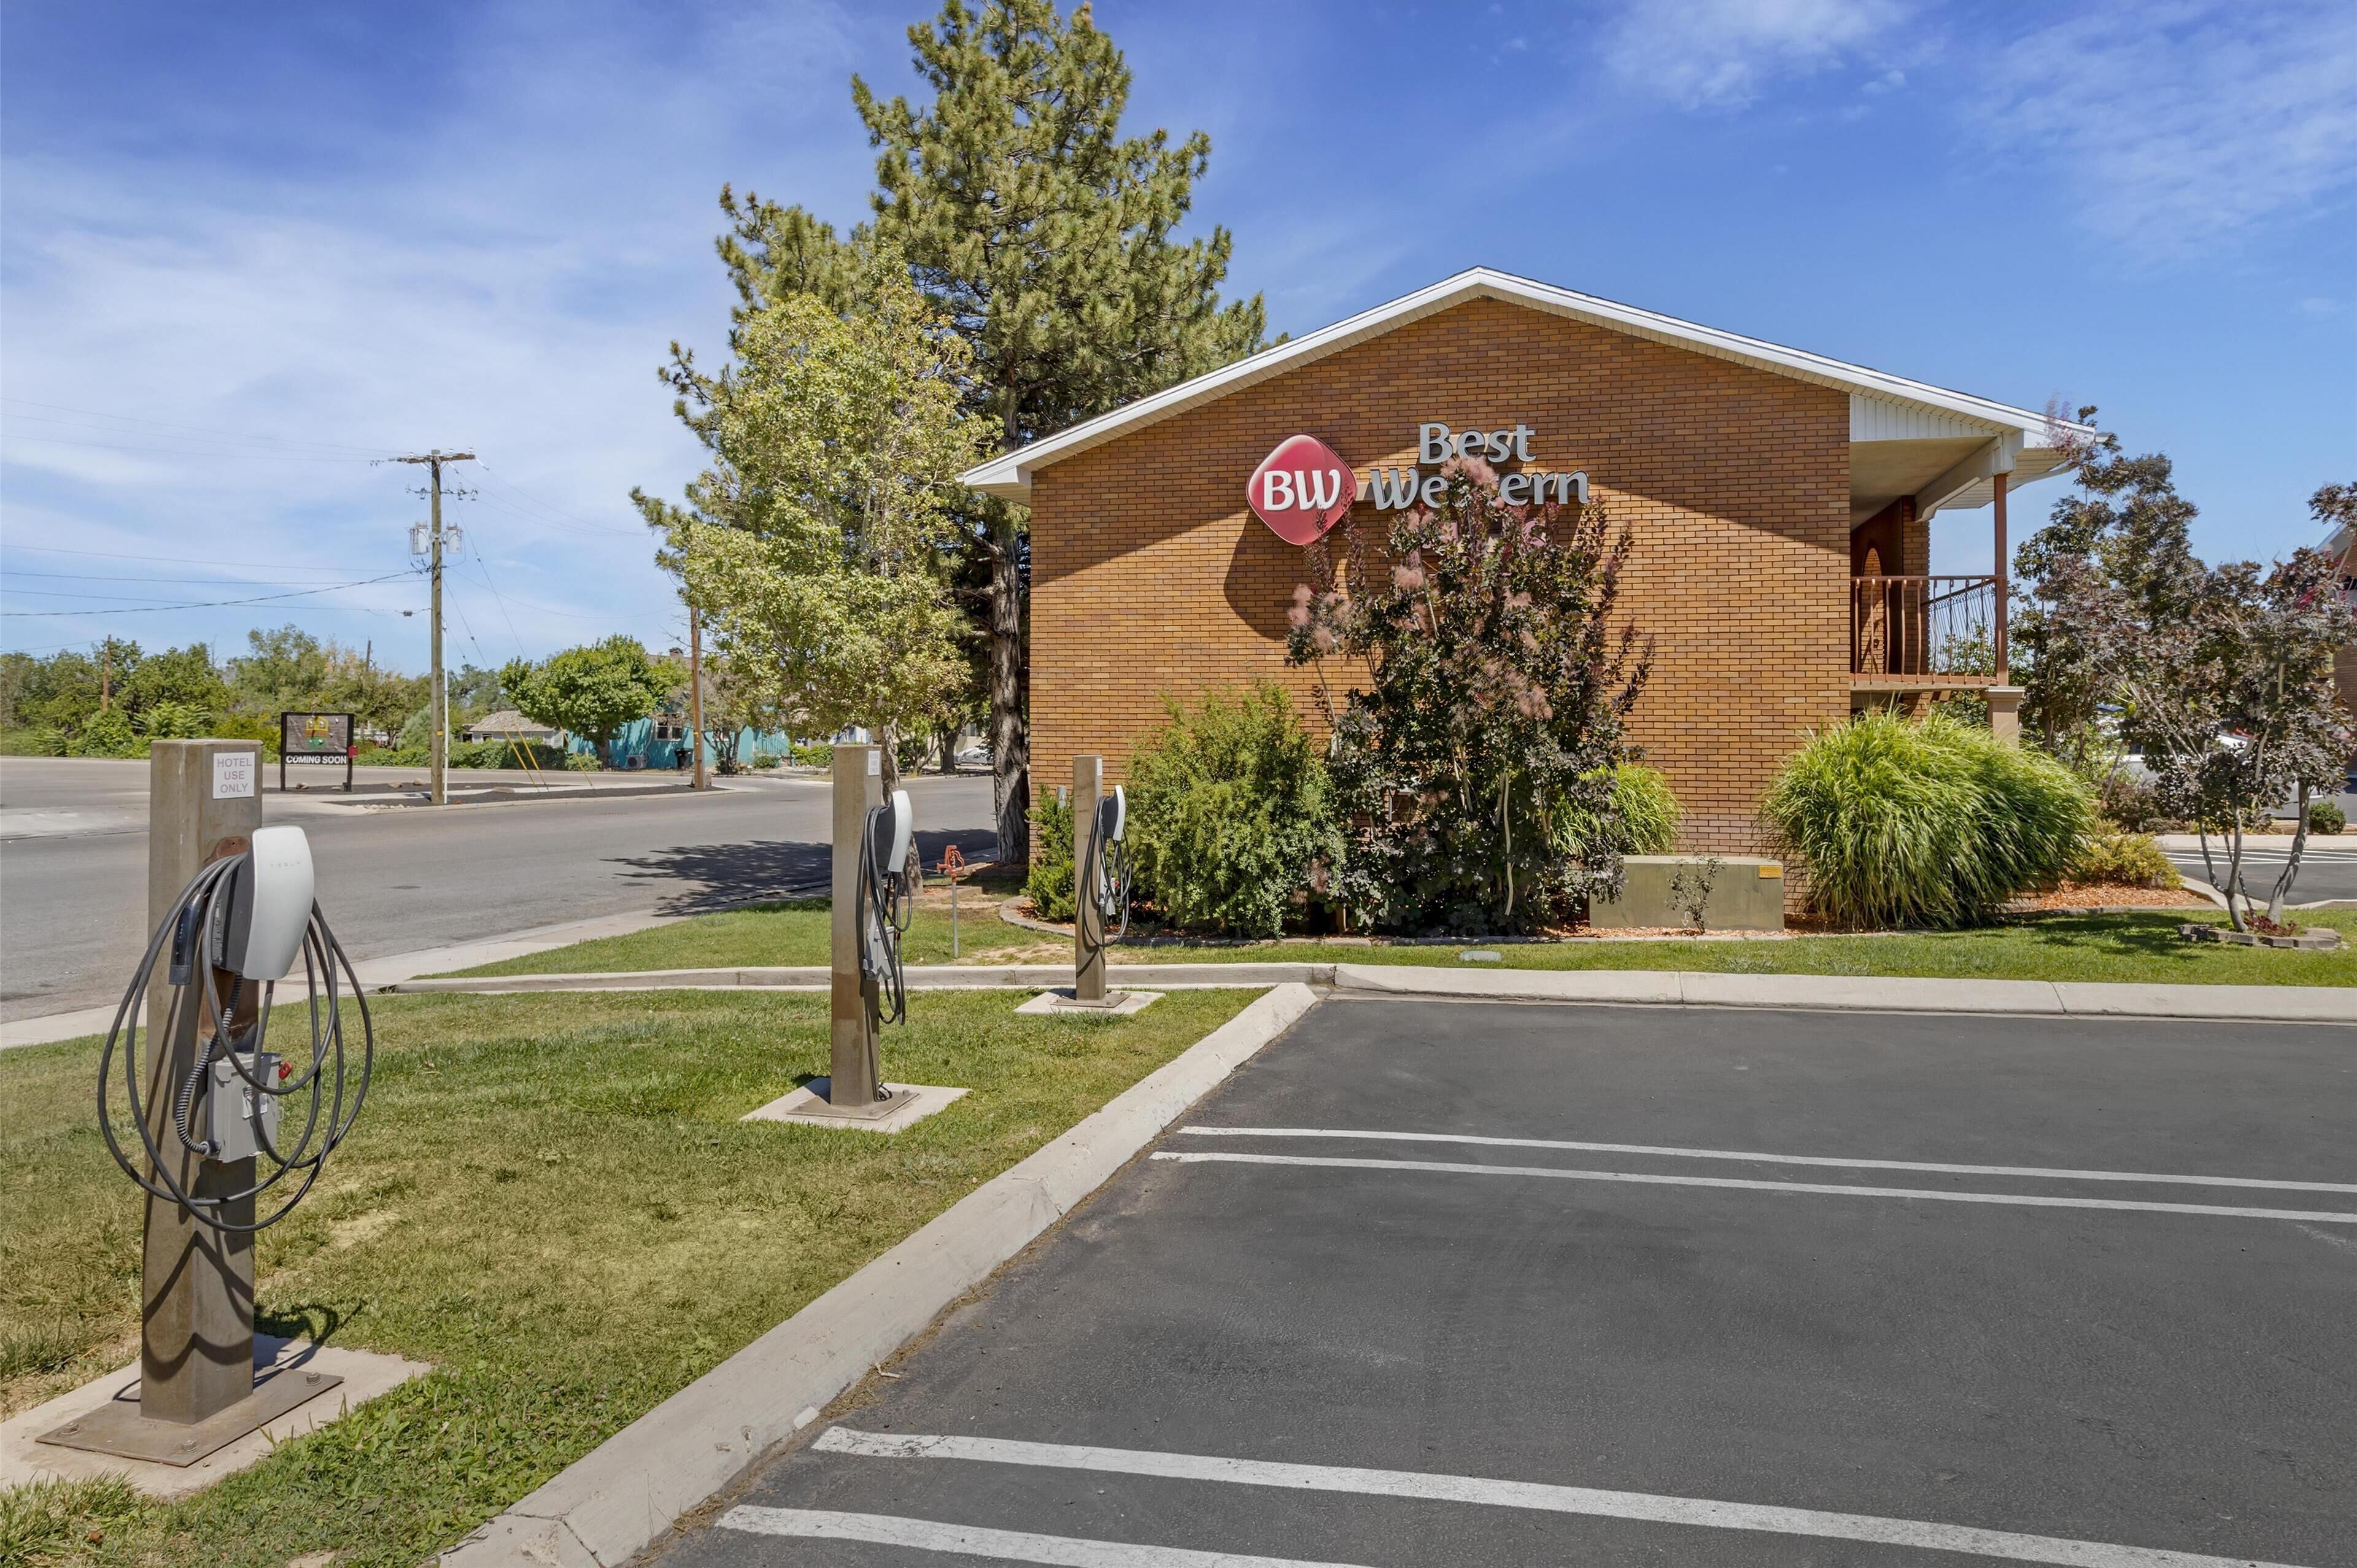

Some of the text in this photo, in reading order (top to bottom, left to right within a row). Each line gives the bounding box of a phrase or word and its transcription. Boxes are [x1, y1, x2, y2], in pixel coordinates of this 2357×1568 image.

[1420, 422, 1537, 464] Best
[1264, 469, 1341, 511] BW
[1370, 466, 1590, 511] Weern
[217, 758, 252, 767] HOTEL
[286, 755, 347, 764] COMING SOON
[224, 771, 245, 780] USE
[220, 783, 248, 793] ONLY
